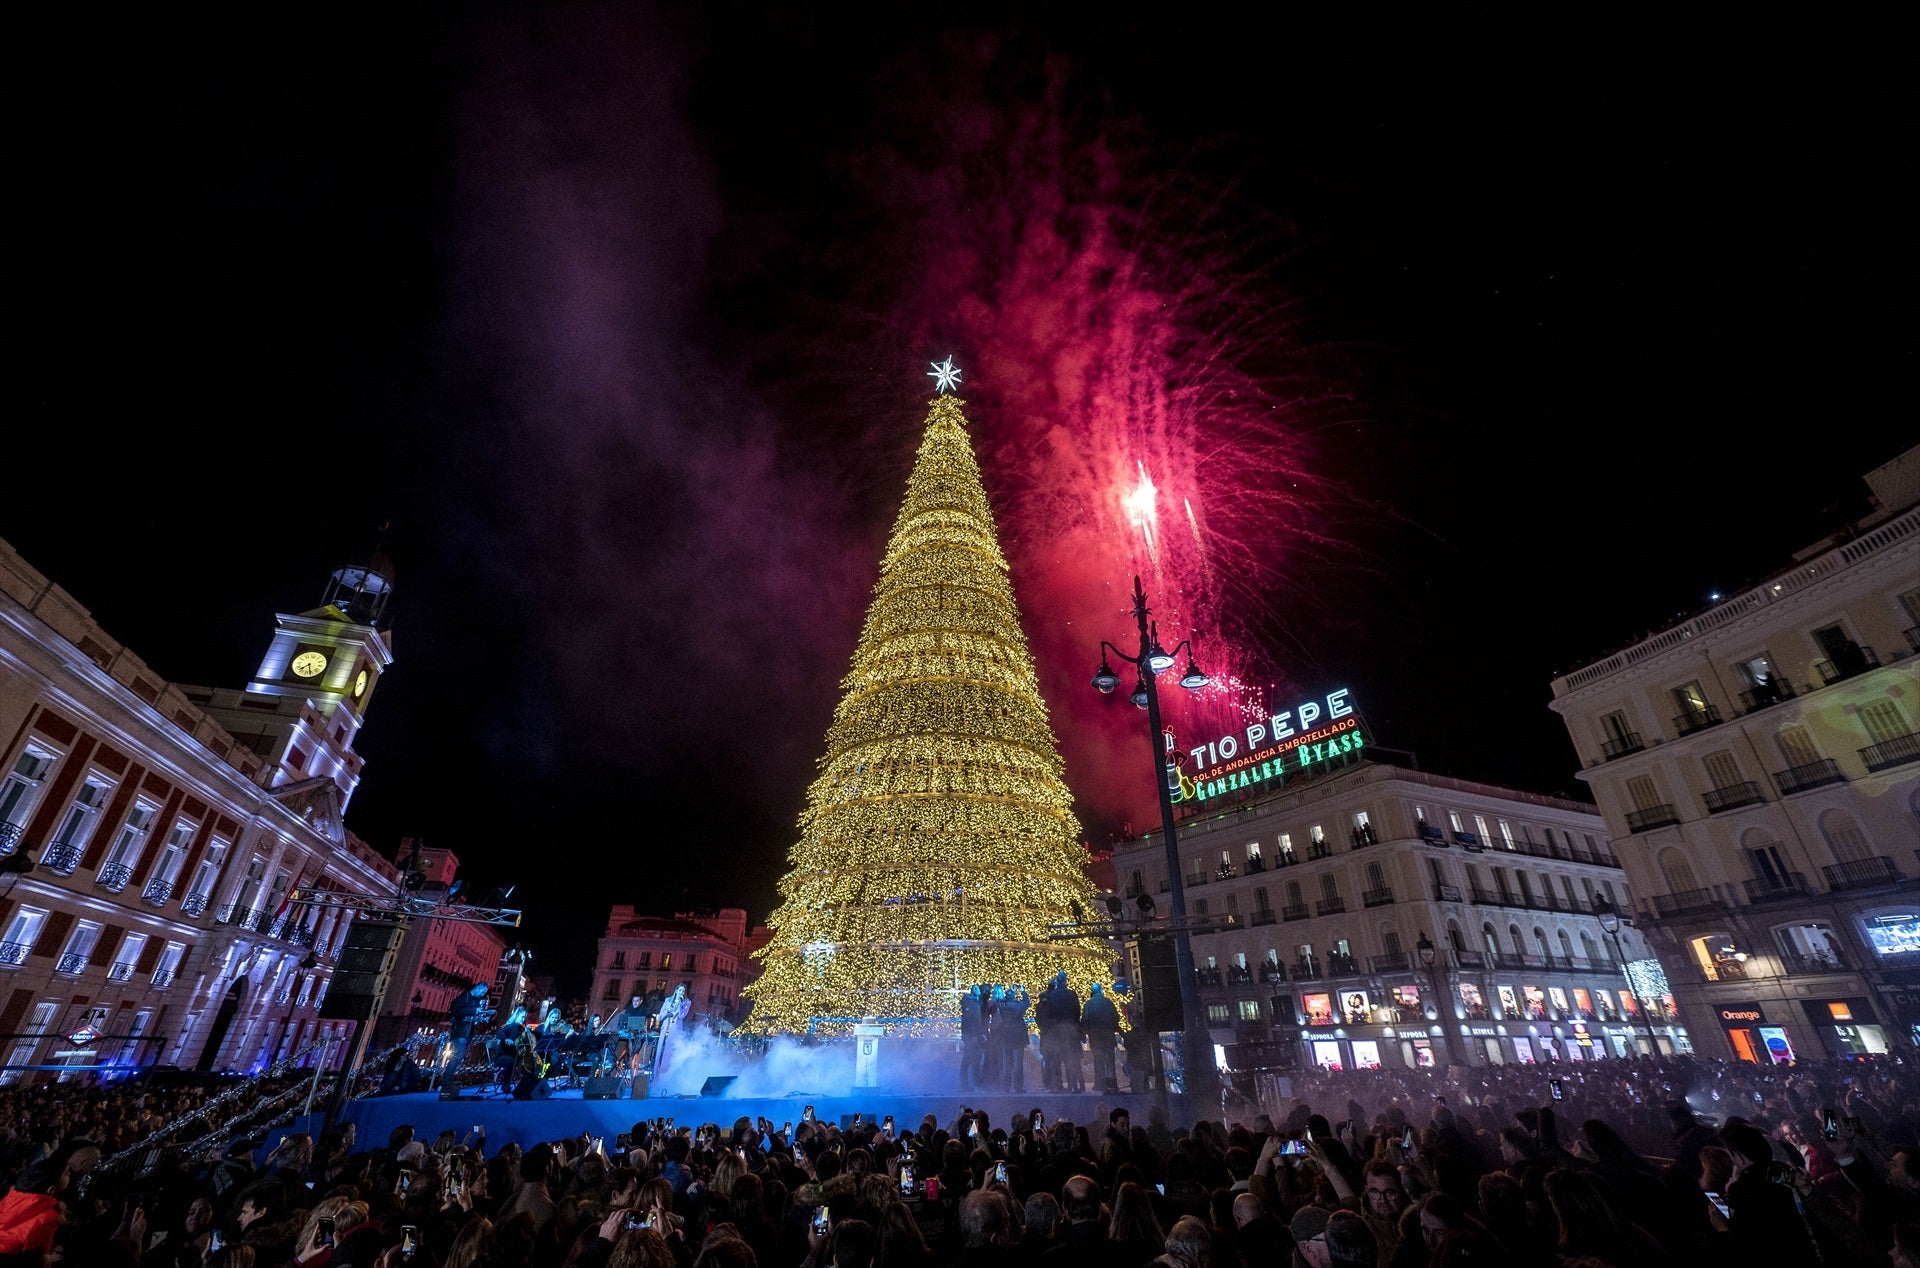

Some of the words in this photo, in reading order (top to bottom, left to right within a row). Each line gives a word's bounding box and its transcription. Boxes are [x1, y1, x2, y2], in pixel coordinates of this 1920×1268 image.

[1191, 736, 1237, 769] TIO
[1246, 688, 1353, 750] PEPE
[1193, 772, 1210, 783] SOL
[1212, 767, 1223, 776] DE
[1226, 748, 1276, 771] ANDALUCIA
[1278, 719, 1355, 752] EMBOTELLADO
[1196, 758, 1283, 800] GONZALEZ
[1298, 731, 1363, 766] BYASS
[1722, 1010, 1760, 1020] Orange
